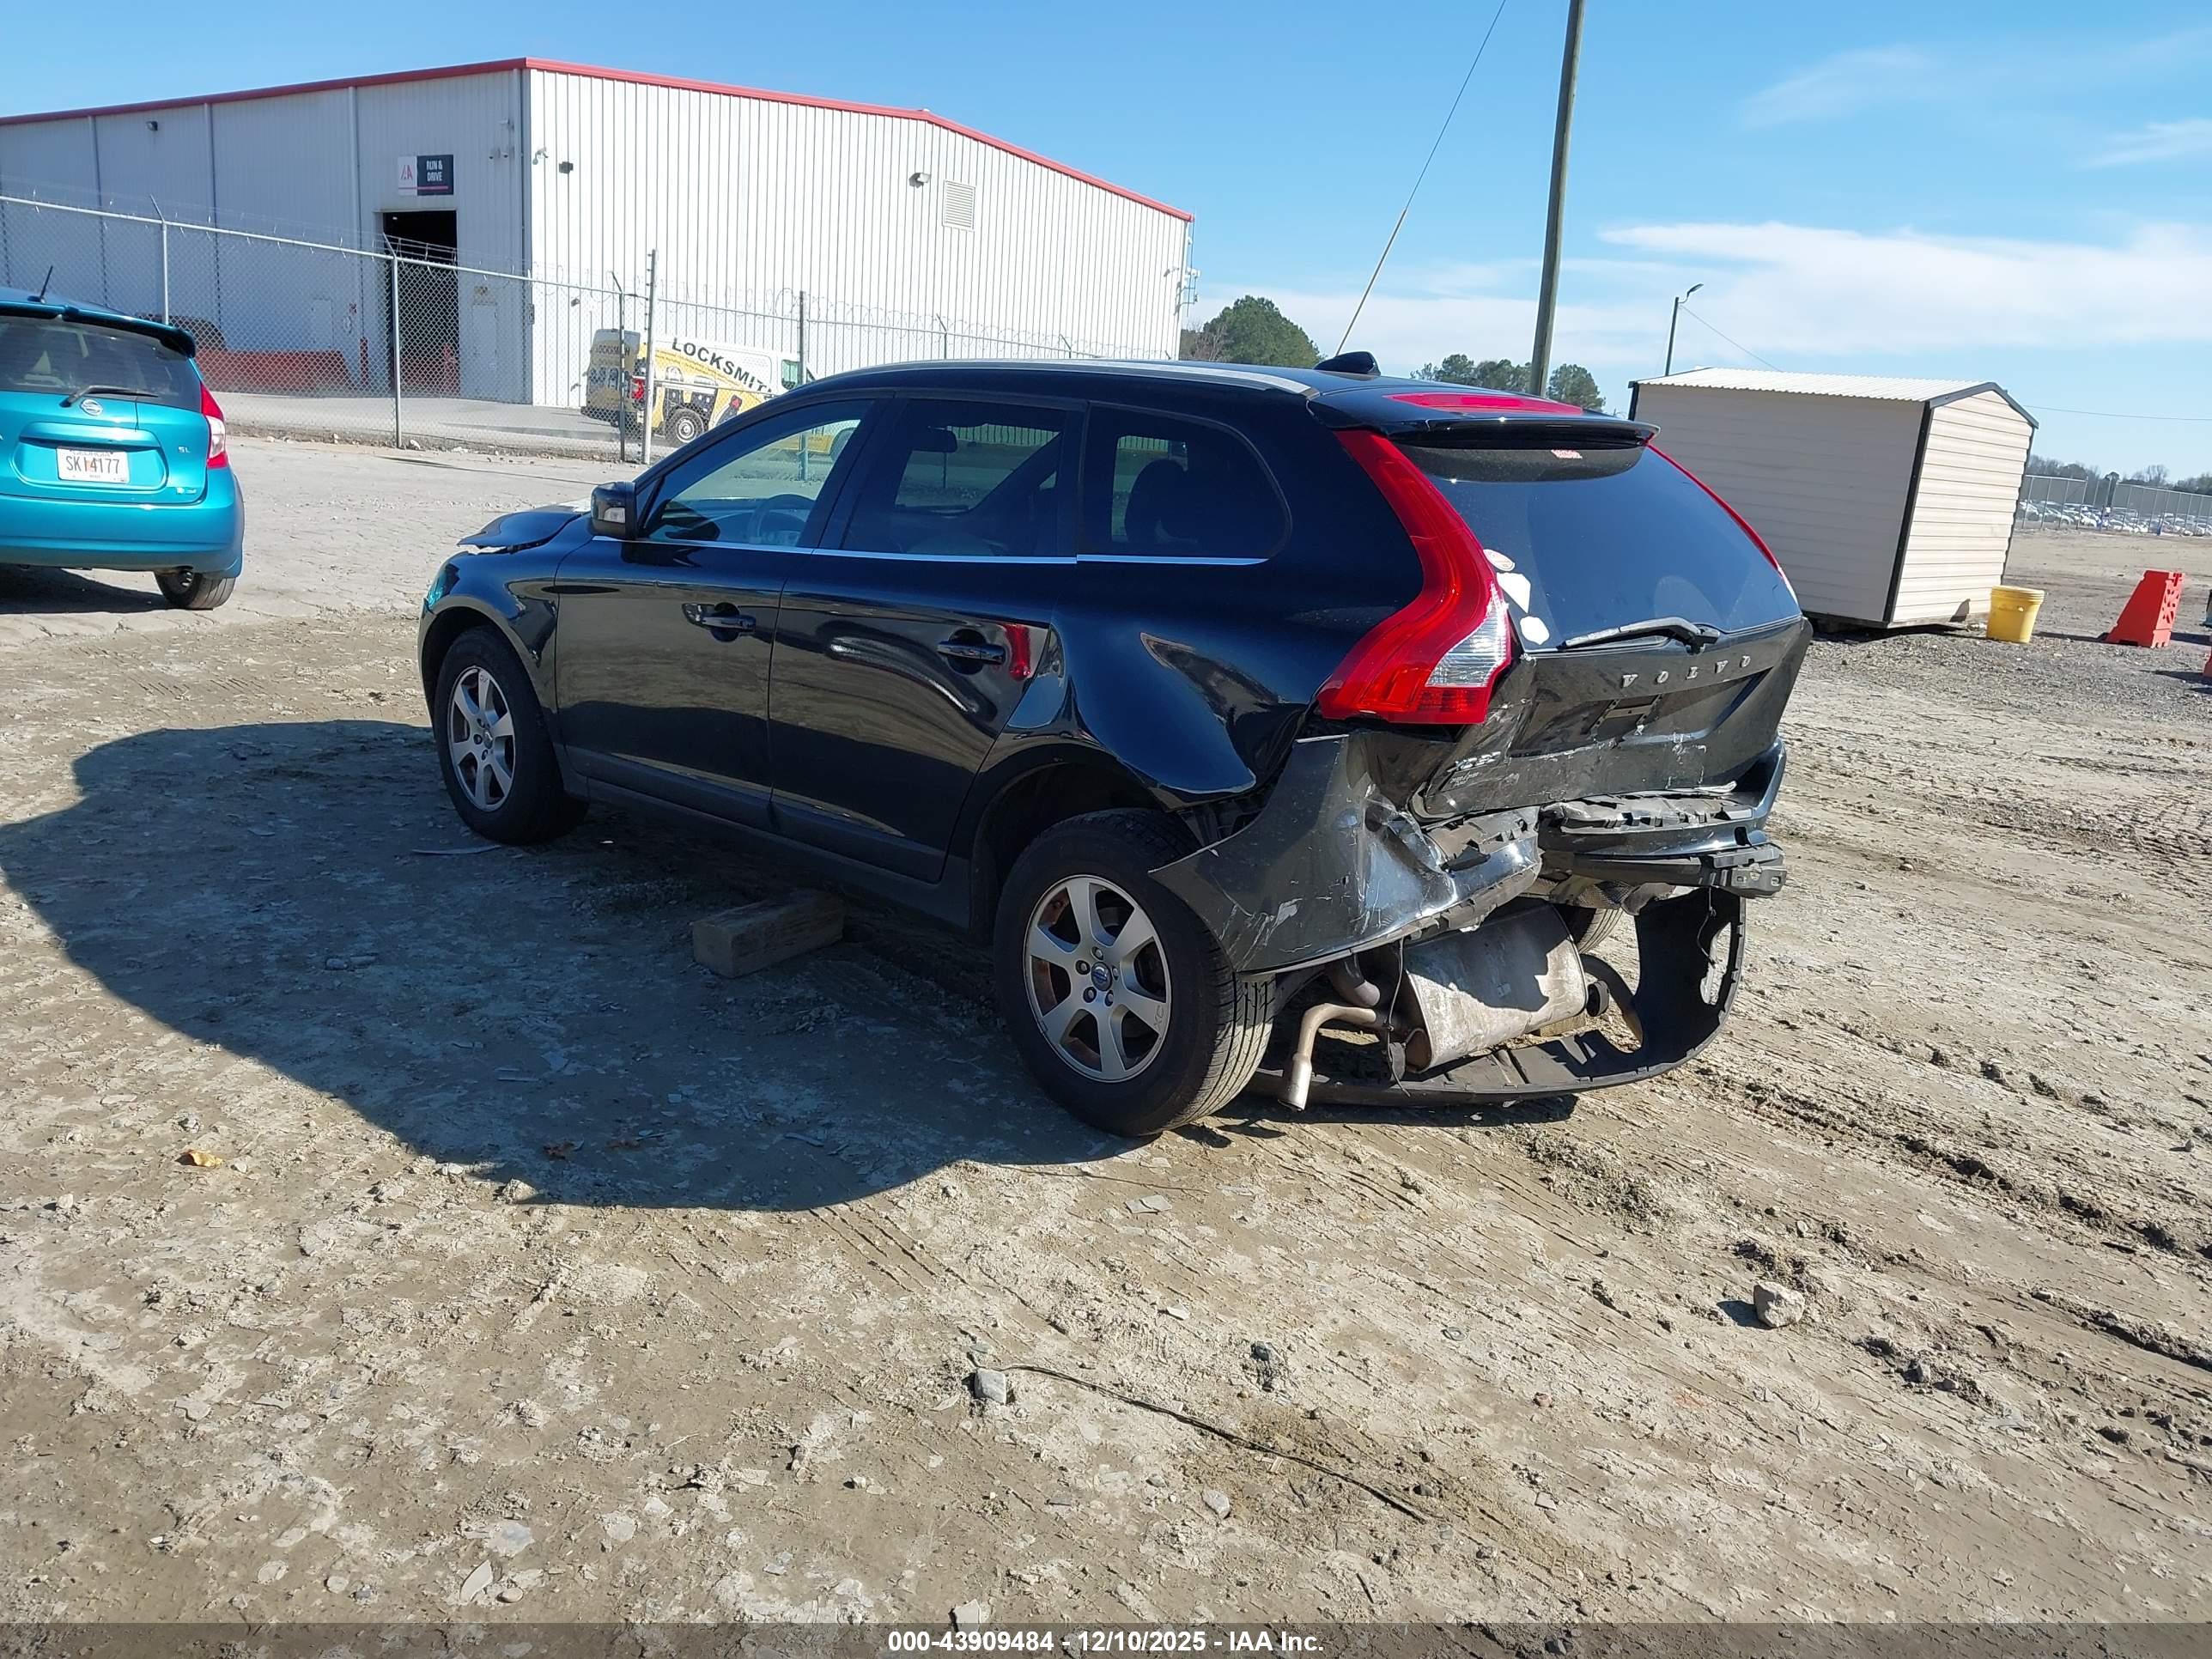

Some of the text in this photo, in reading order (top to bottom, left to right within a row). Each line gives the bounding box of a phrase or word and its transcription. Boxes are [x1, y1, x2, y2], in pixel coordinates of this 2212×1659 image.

[426, 160, 443, 170] RUN &
[427, 171, 443, 182] DRIVE
[1621, 655, 1751, 688] VOLVO
